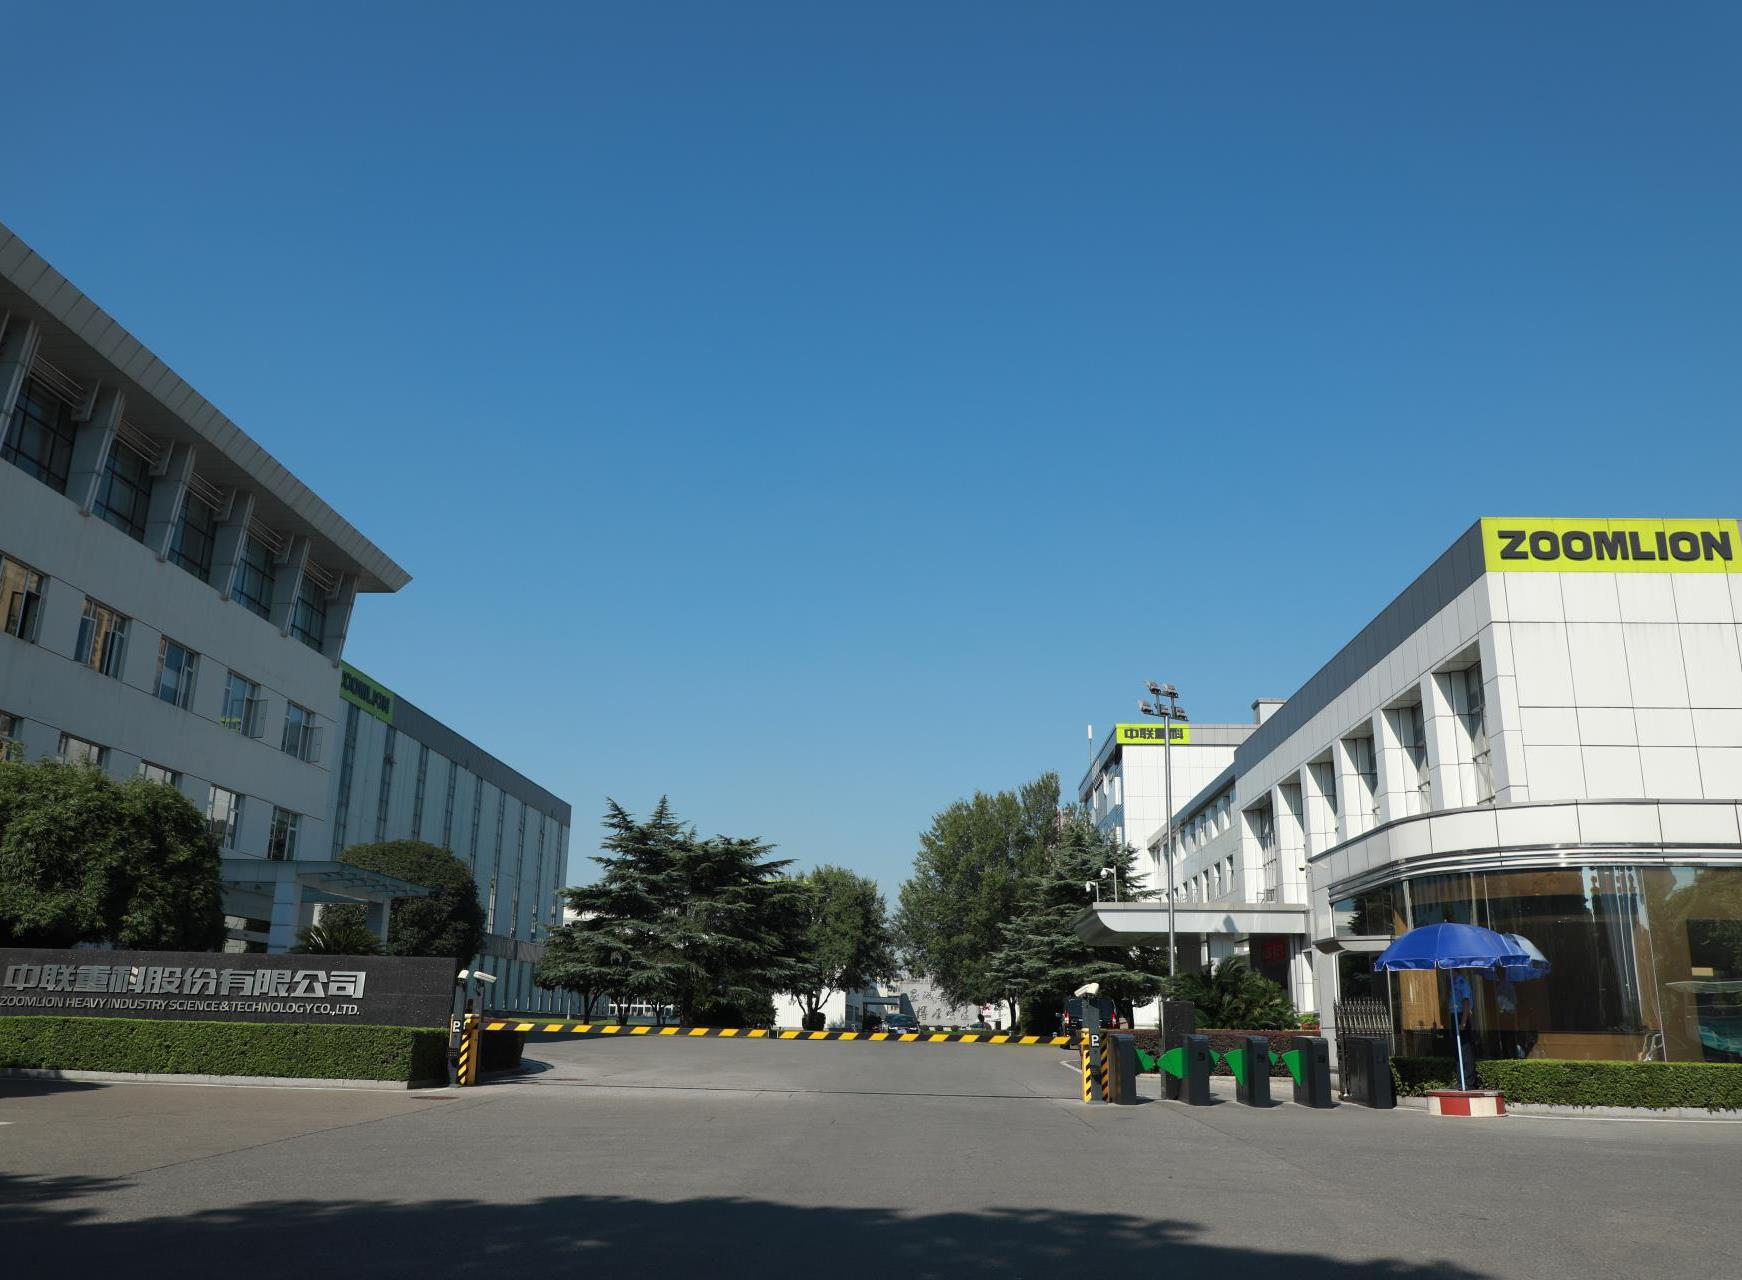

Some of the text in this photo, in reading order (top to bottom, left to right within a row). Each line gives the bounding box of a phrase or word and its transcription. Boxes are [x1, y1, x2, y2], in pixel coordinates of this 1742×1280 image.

[1497, 530, 1733, 562] ZOOMLION
[3, 963, 366, 999] 中联重科股份有限公司
[0, 995, 64, 1008] ZOOMLION
[66, 997, 108, 1009] HEAVY
[108, 998, 169, 1011] INDUSTRY
